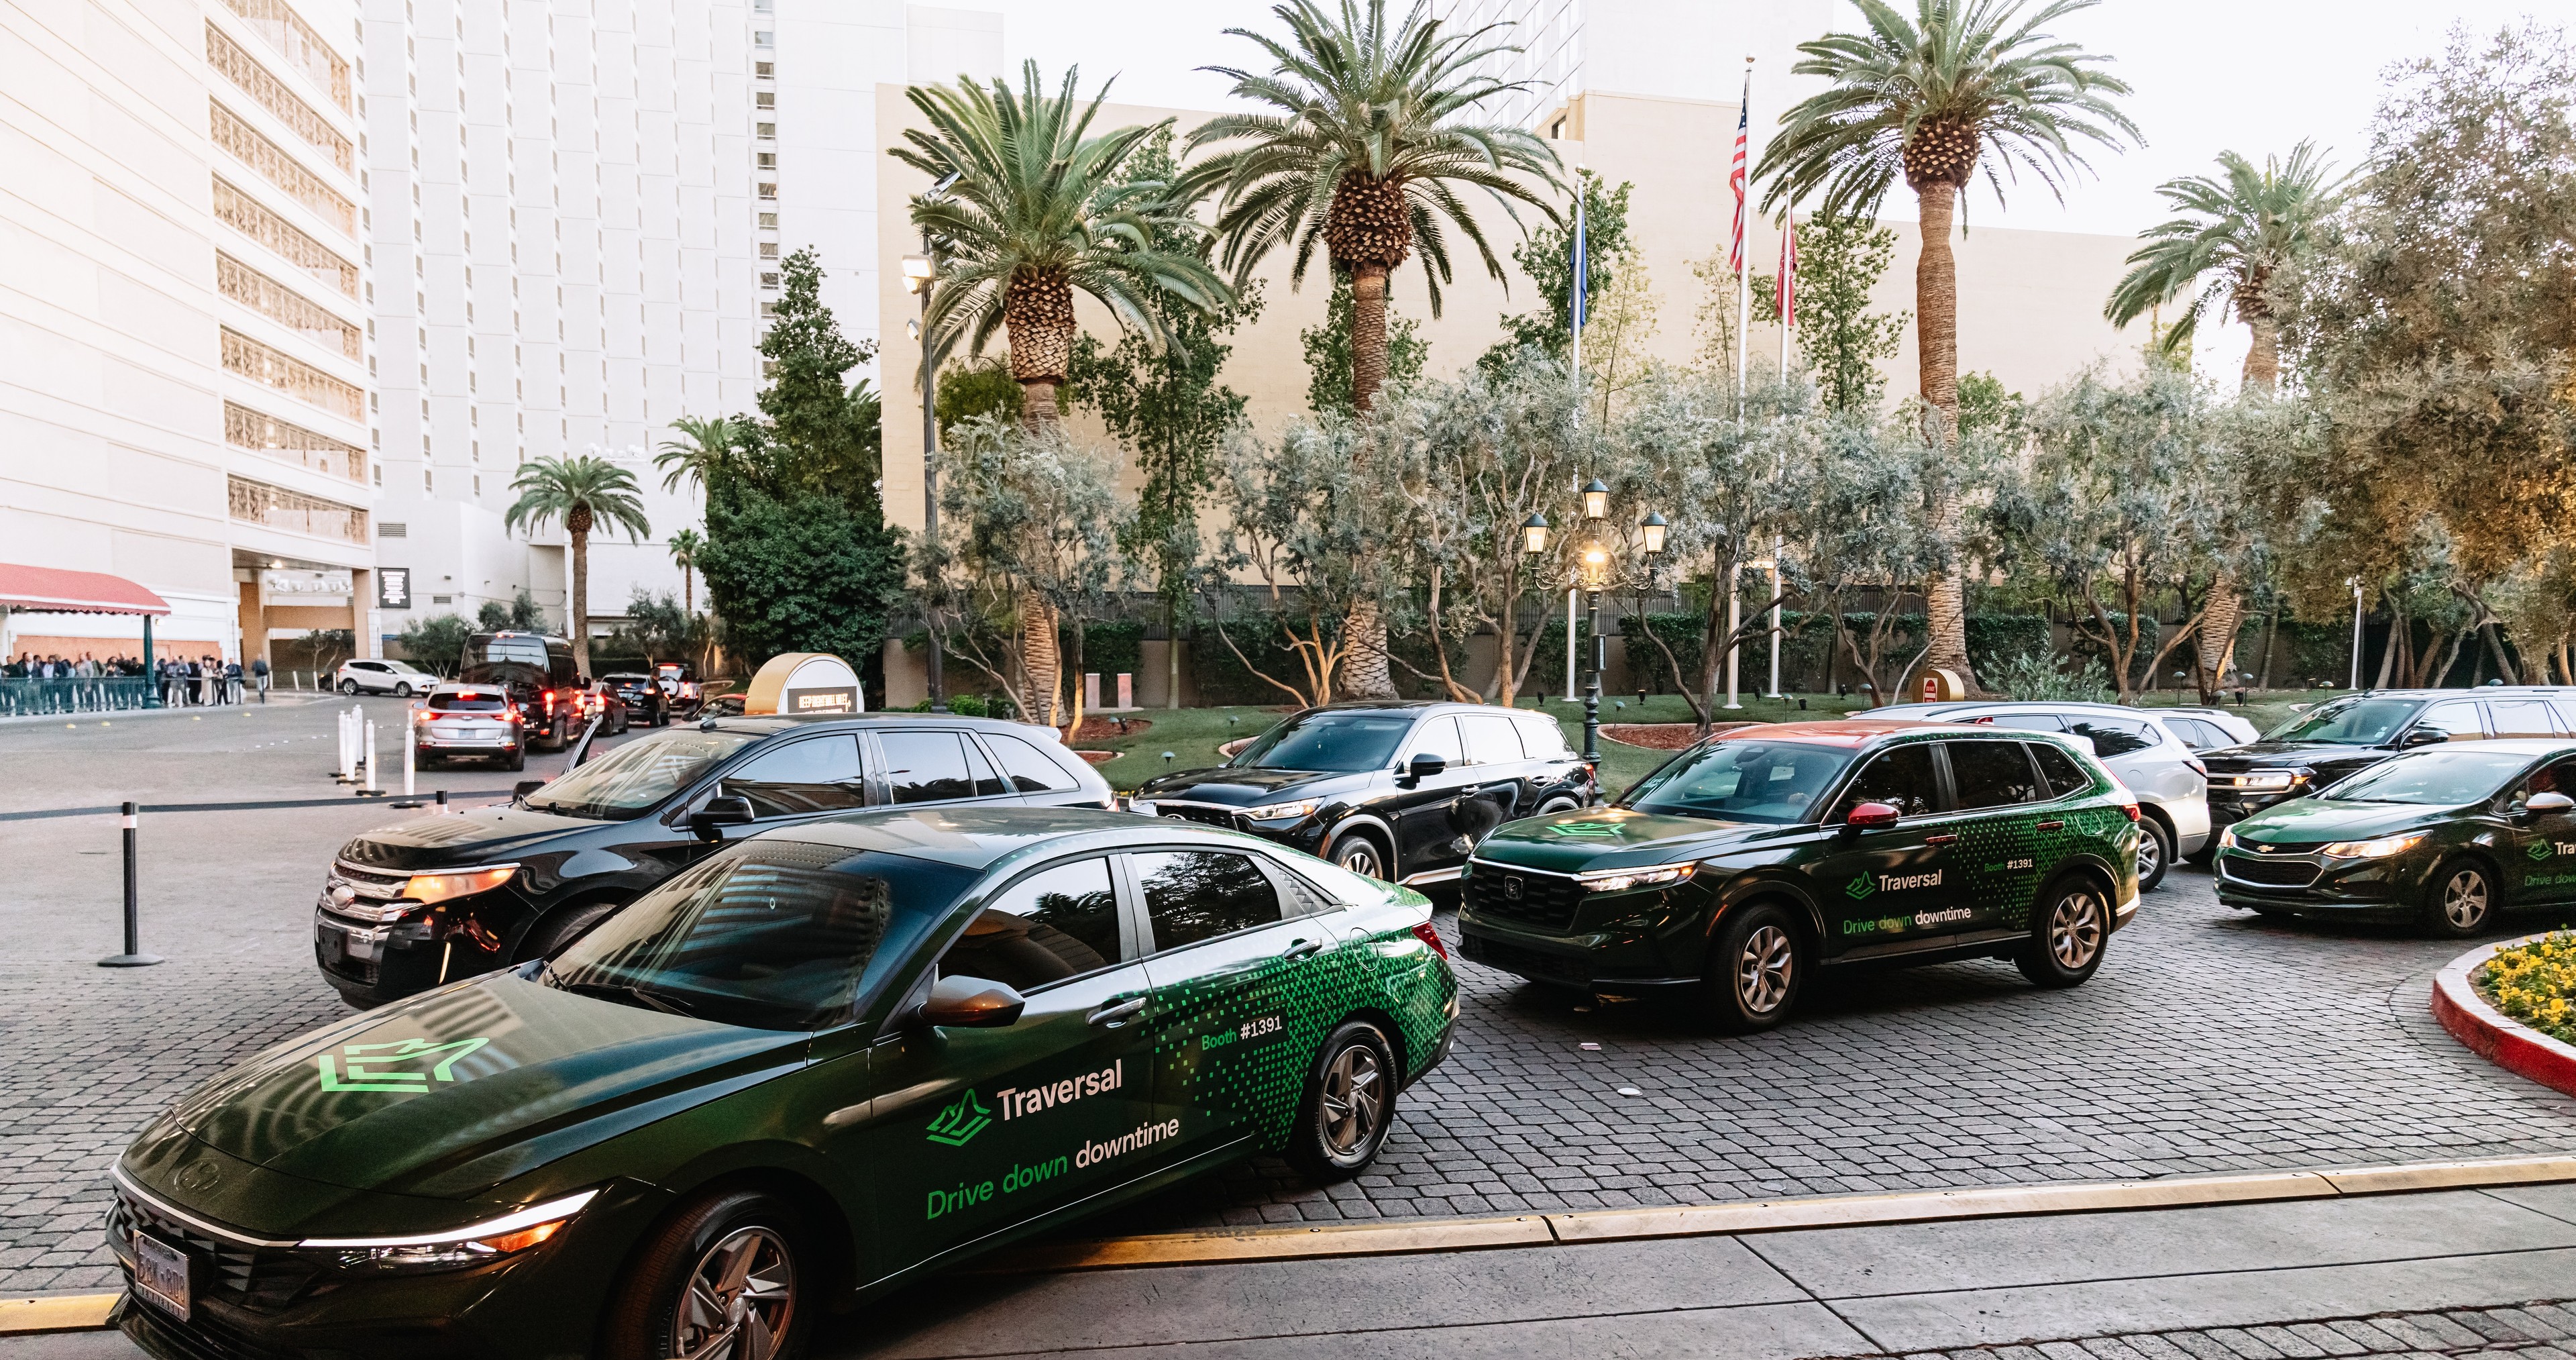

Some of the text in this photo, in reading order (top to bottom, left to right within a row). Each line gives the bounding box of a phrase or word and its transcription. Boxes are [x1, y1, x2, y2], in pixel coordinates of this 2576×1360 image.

[2555, 841, 2576, 855] Tra
[1984, 858, 2033, 872] Booth #1391
[1879, 869, 1942, 892] Traversal
[2524, 874, 2552, 886] Drive
[1843, 906, 1972, 934] Drive down downtime
[1201, 1015, 1283, 1051] Booth #1391
[997, 1059, 1122, 1121] Traversal
[927, 1118, 1179, 1220] Drive down downtime
